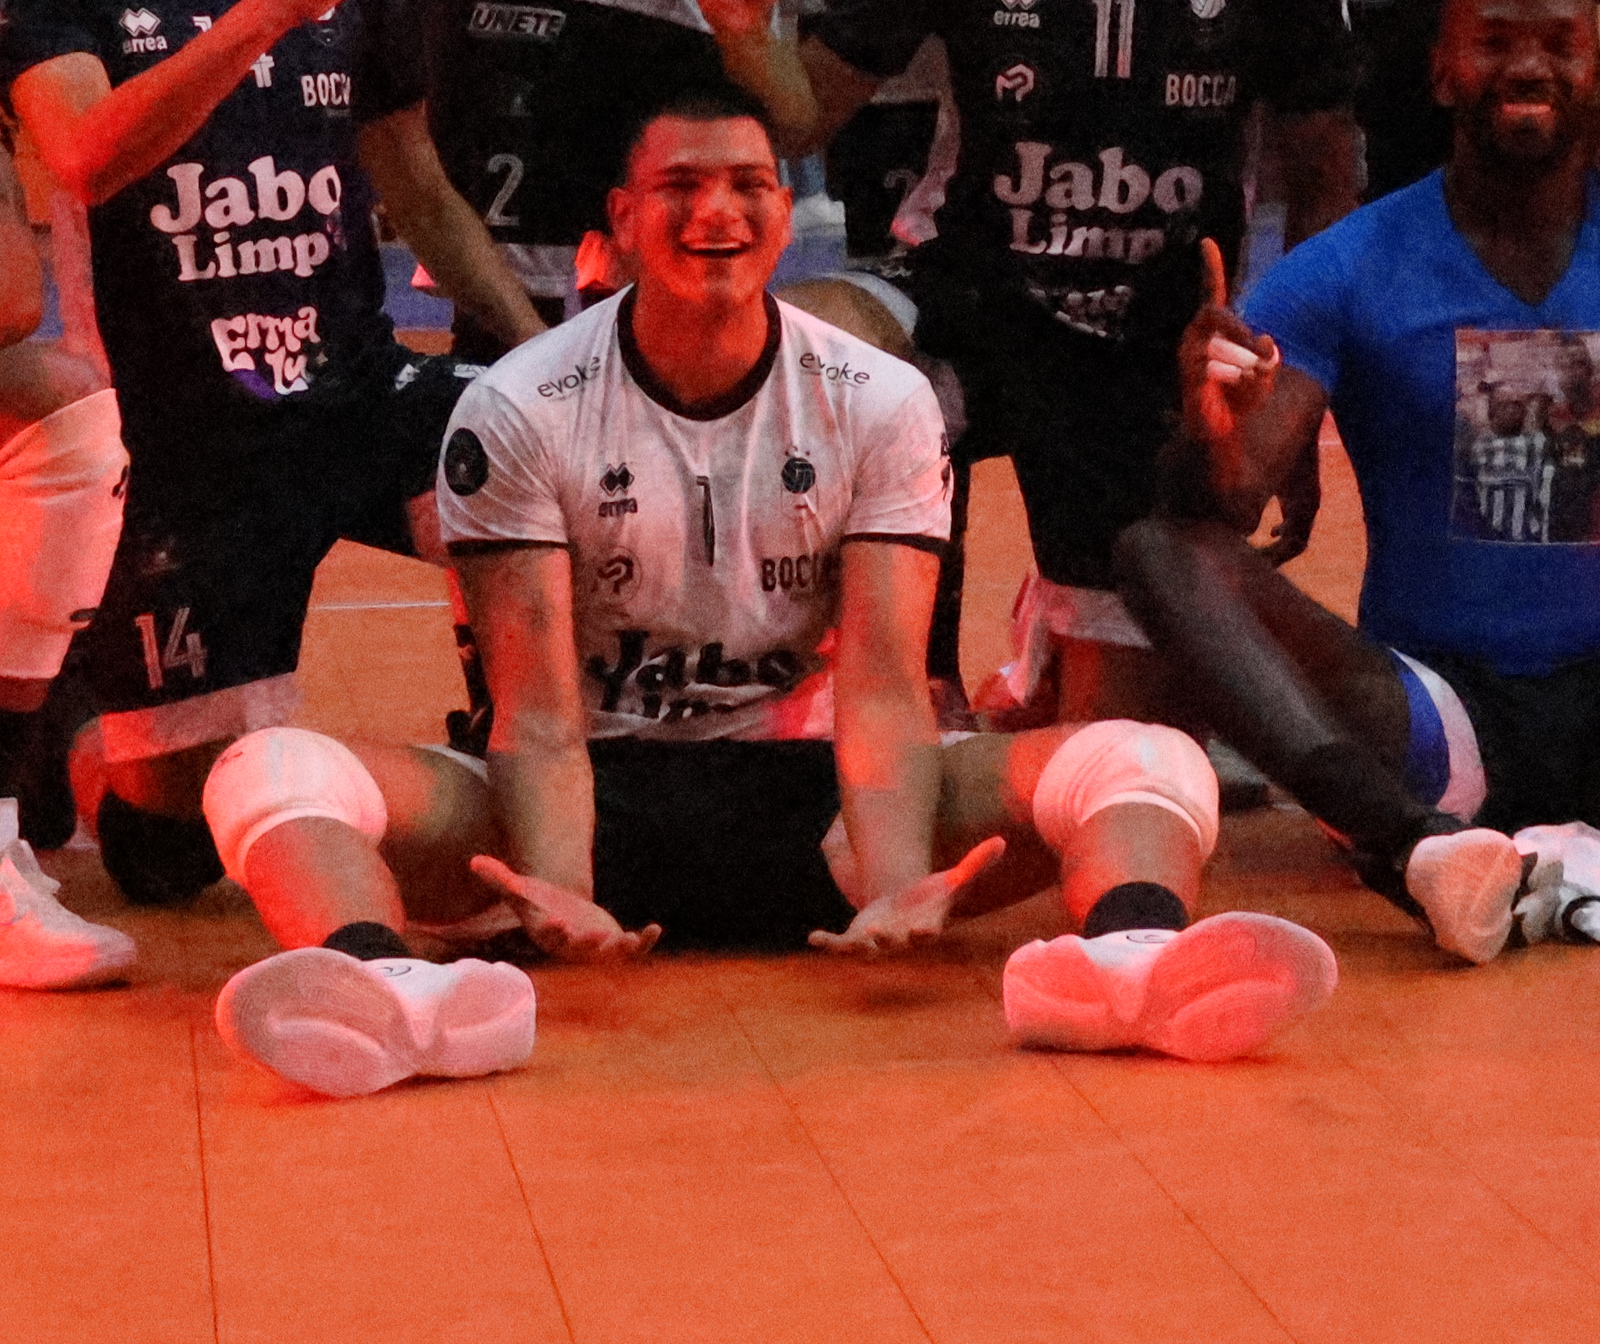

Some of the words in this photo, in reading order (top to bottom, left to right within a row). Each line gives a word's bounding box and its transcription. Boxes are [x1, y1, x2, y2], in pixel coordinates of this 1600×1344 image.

[994, 9, 1040, 29] errea
[122, 35, 168, 54] errea
[1165, 73, 1238, 107] BOCCA
[149, 156, 342, 233] Jabo
[484, 154, 525, 227] 2
[994, 141, 1203, 215] Jabo
[171, 232, 330, 282] Limp
[537, 356, 601, 399] evoke
[800, 352, 870, 385] evoke
[696, 474, 716, 567] 1
[136, 607, 206, 690] 14
